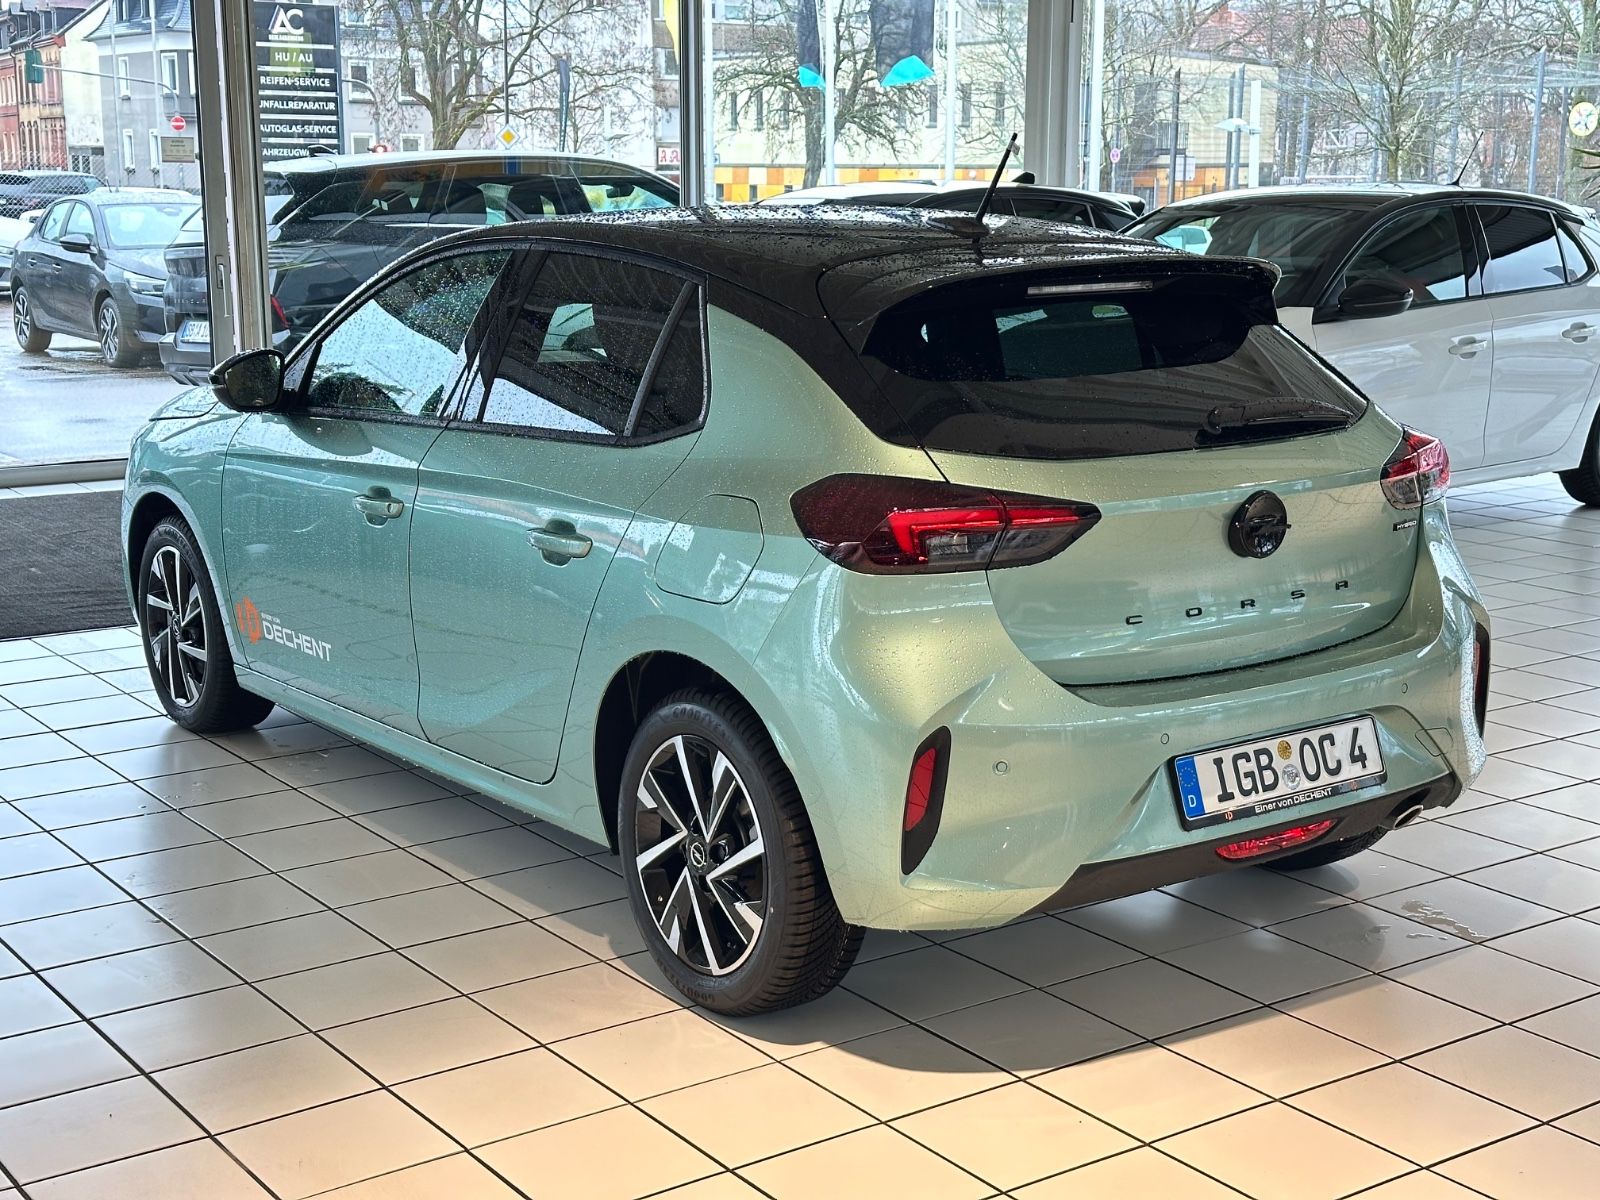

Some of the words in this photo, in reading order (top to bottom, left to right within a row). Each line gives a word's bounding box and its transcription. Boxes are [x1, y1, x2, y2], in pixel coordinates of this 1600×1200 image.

[268, 5, 304, 35] AC
[275, 52, 290, 62] HU
[292, 52, 297, 62] /
[298, 53, 313, 63] AU
[260, 77, 331, 87] REIFEN-SERVICE
[1125, 579, 1349, 626] CORSA
[262, 620, 332, 662] DECHENT
[1212, 747, 1280, 803] IGB
[1299, 732, 1342, 782] OC
[1349, 727, 1368, 769] 4
[1187, 794, 1197, 808] D
[1254, 801, 1276, 813] Einer
[1277, 798, 1293, 808] von
[1294, 787, 1333, 804] DECHENT
